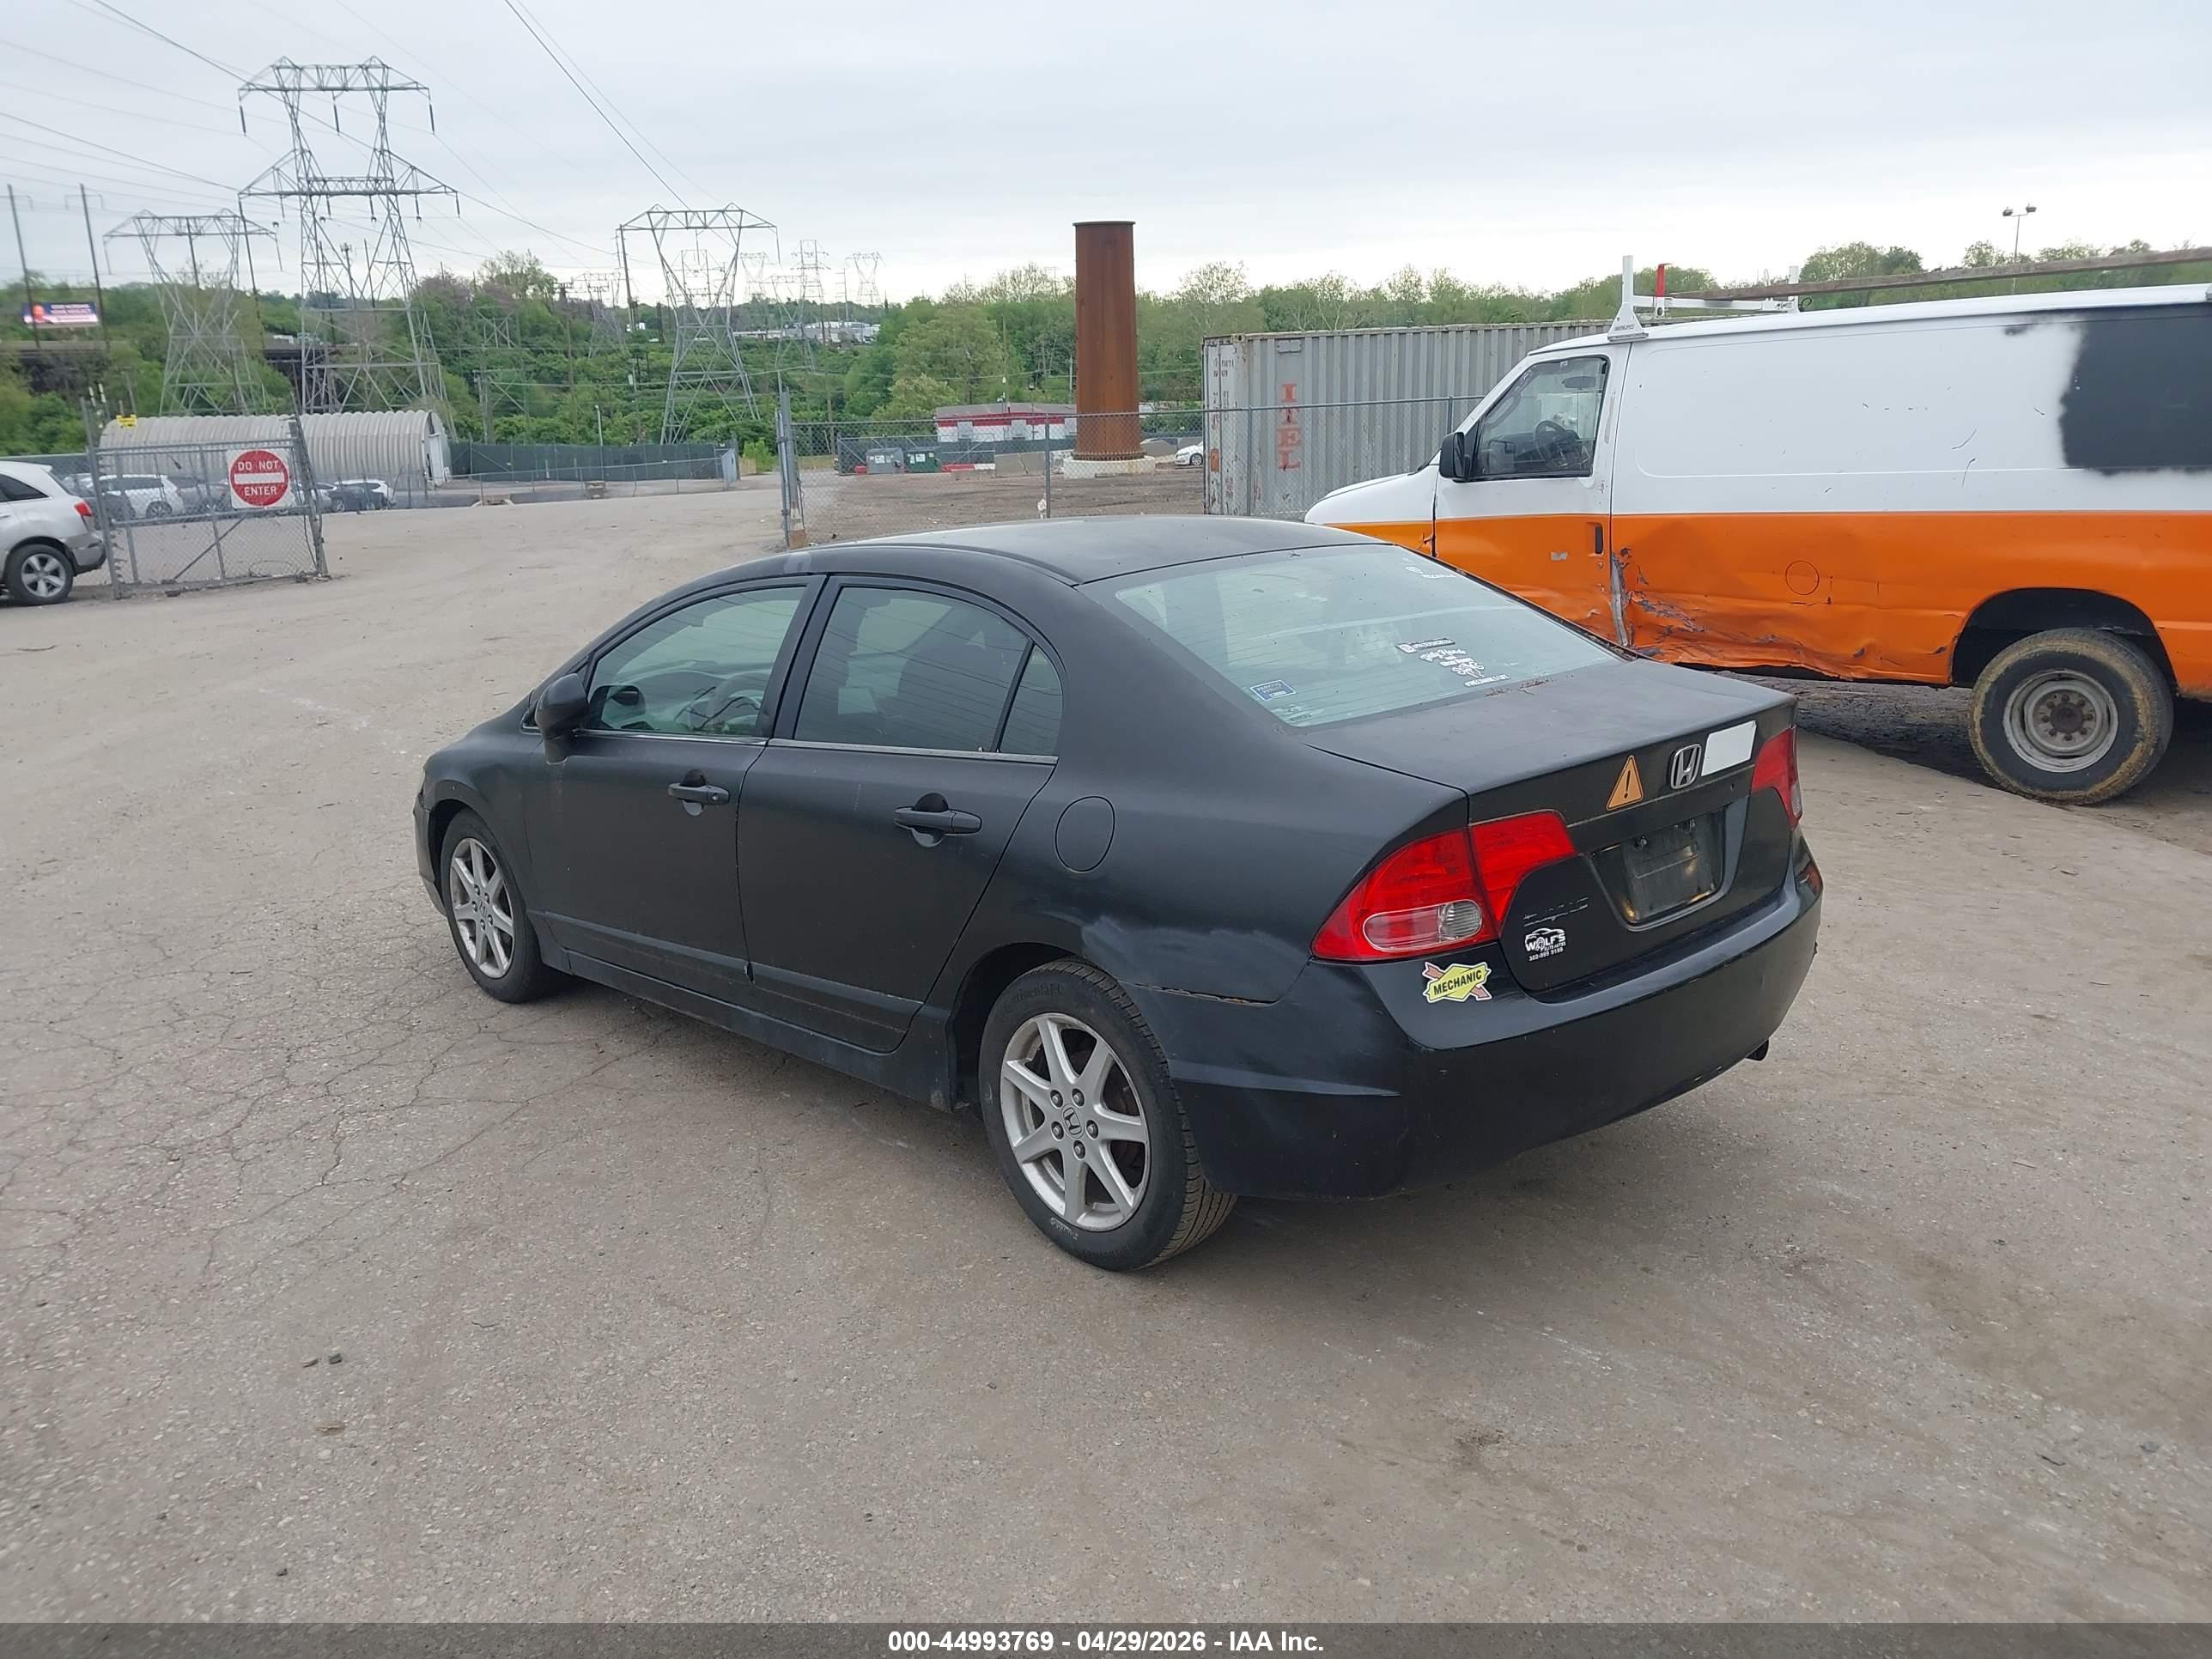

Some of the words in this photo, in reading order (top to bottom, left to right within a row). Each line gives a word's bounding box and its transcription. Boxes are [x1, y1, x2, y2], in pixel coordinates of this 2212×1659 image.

[237, 461, 252, 471] DO
[258, 459, 279, 471] NOT
[244, 486, 277, 496] ENTER
[1433, 969, 1482, 995] MECHANIC
